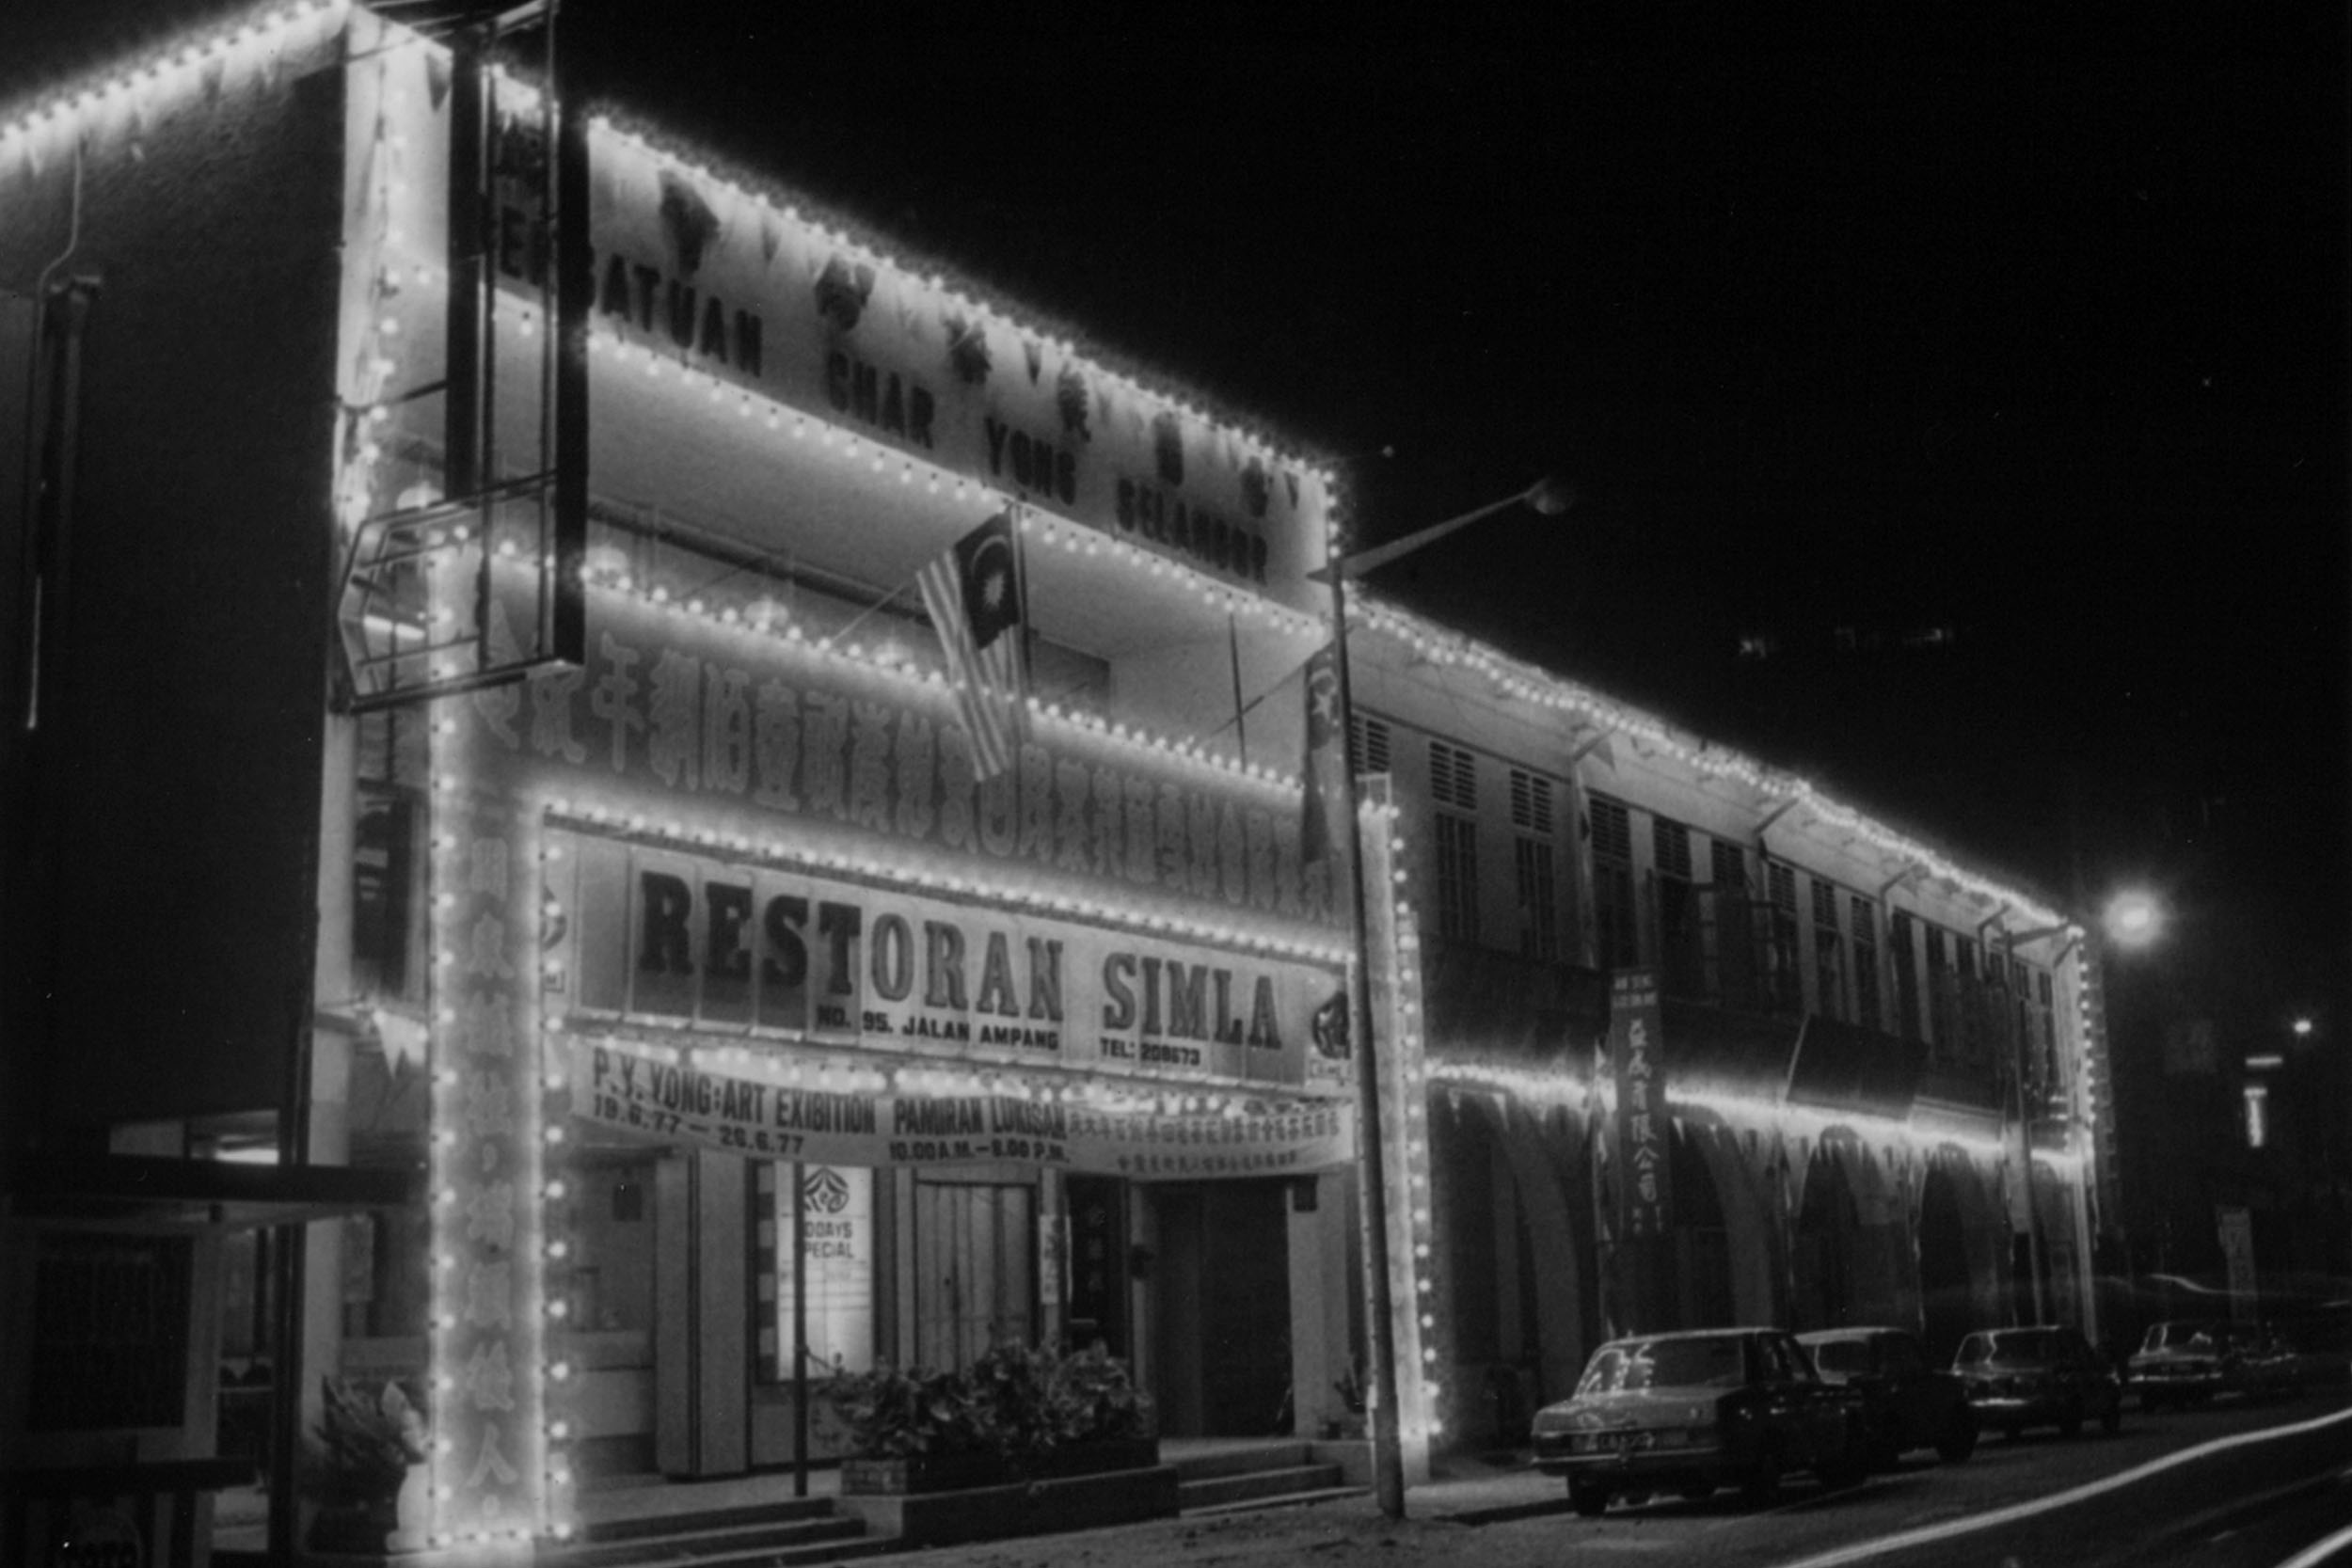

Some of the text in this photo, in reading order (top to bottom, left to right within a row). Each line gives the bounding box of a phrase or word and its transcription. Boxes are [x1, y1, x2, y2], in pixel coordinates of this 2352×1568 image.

[984, 416, 1076, 506] YONG
[638, 870, 1281, 1051] RESTORAN SIMLA
[816, 1005, 850, 1030] NO.
[901, 1017, 970, 1041] JALAN
[979, 1025, 1059, 1051] AMPANG
[1100, 1037, 1136, 1059] TEL:
[776, 1087, 876, 1134] EXIBITION
[803, 1220, 853, 1239] ODAYS
[803, 1241, 854, 1259] PECIAL
